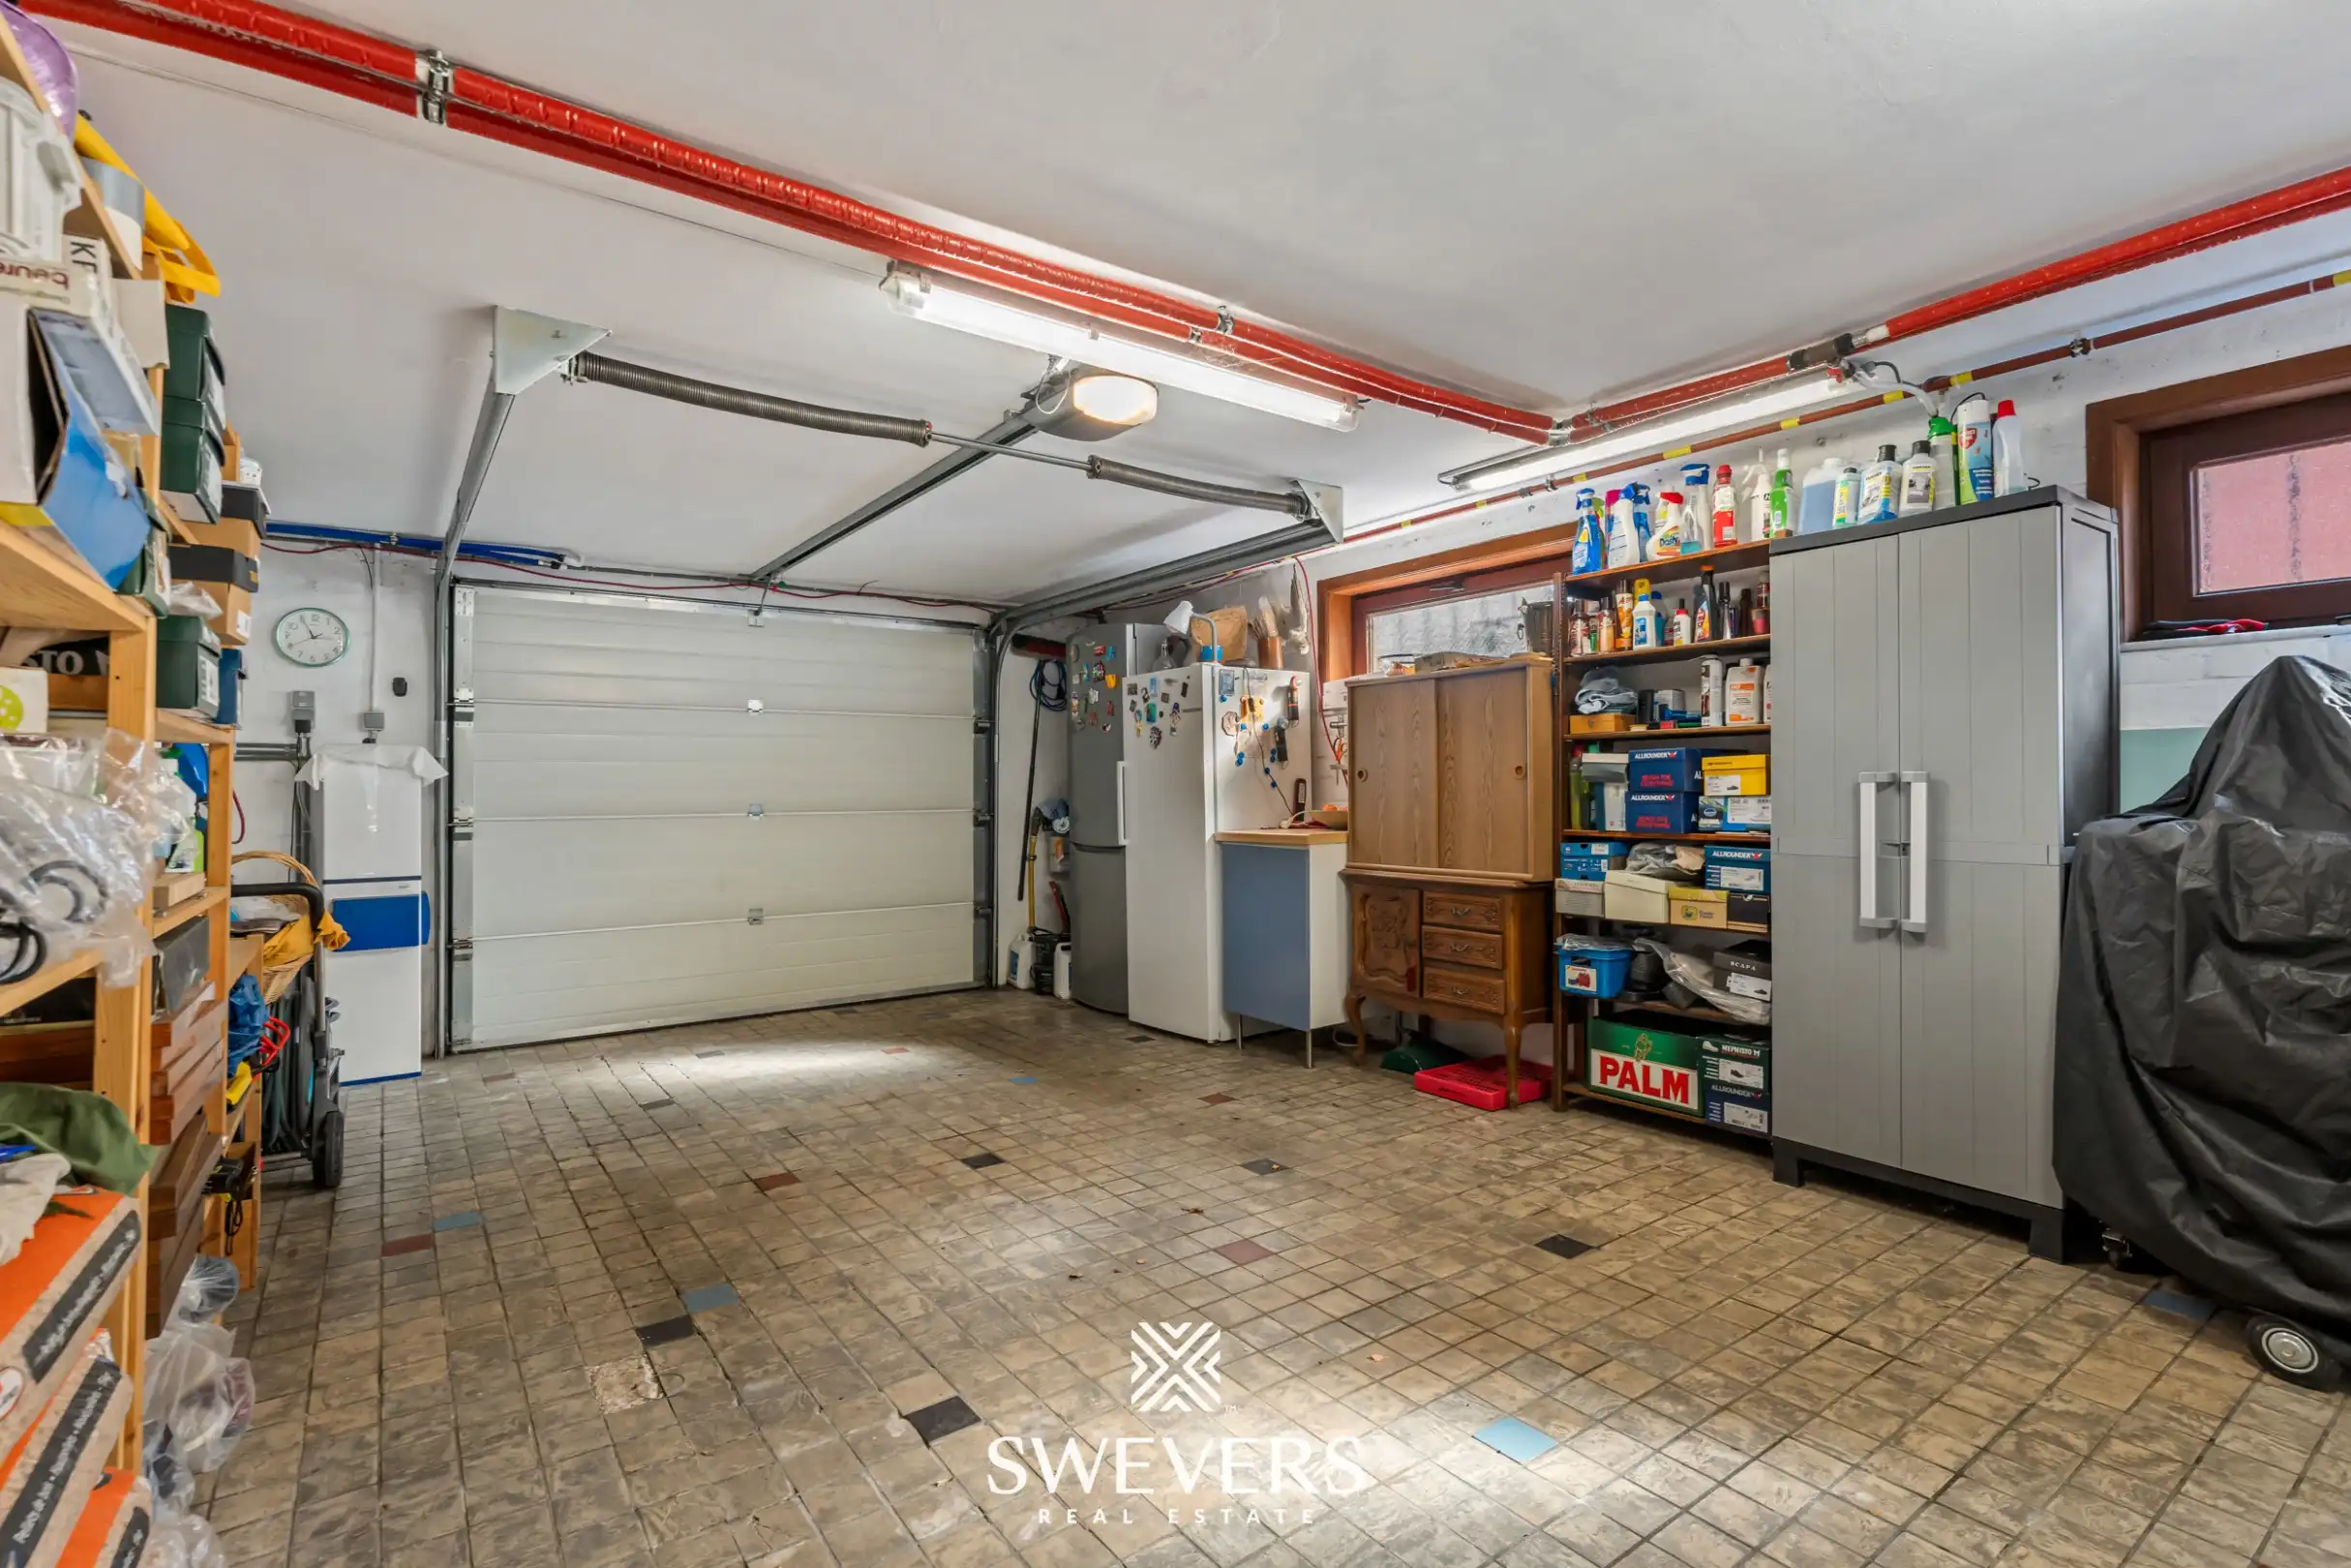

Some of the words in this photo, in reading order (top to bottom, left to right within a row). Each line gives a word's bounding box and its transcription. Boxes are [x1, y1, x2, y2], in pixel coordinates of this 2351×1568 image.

[1711, 850, 1751, 859] ALLROUNDER
[1730, 960, 1757, 972] SCAPA
[1599, 1055, 1689, 1104] PALM
[1710, 1083, 1752, 1098] ALLROUNDER
